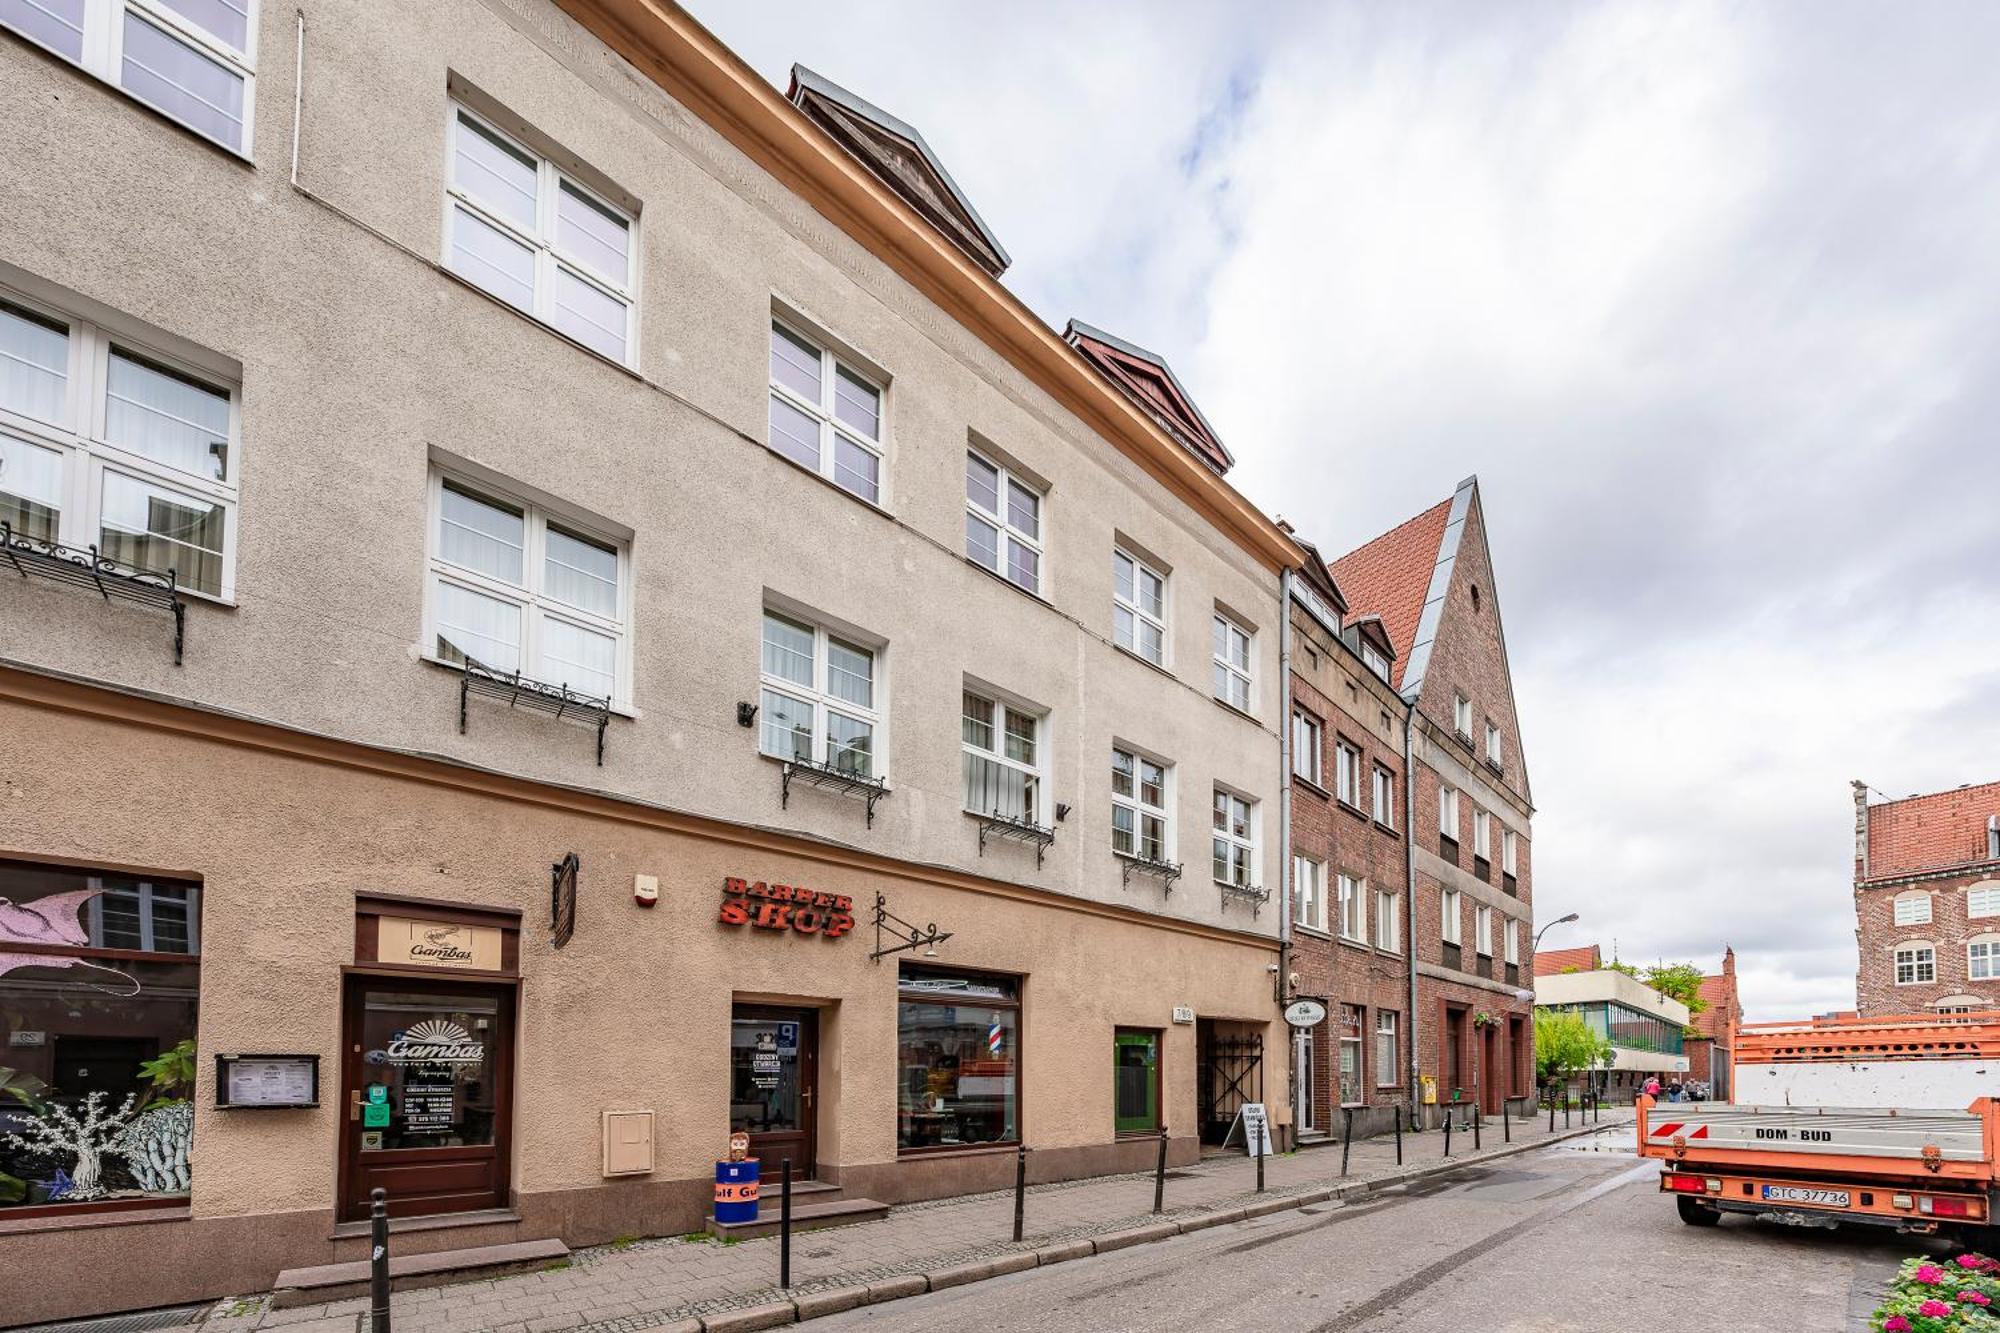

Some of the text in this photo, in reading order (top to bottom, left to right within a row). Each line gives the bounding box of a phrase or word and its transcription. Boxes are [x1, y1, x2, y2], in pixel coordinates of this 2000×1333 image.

[722, 876, 853, 913] BARBER
[719, 899, 855, 938] SHOP
[410, 944, 472, 960] Gambas
[387, 1040, 484, 1059] Gambas
[1756, 1128, 1788, 1140] DOM
[1800, 1130, 1832, 1142] BUD
[1770, 1187, 1848, 1204] GTC 37736
